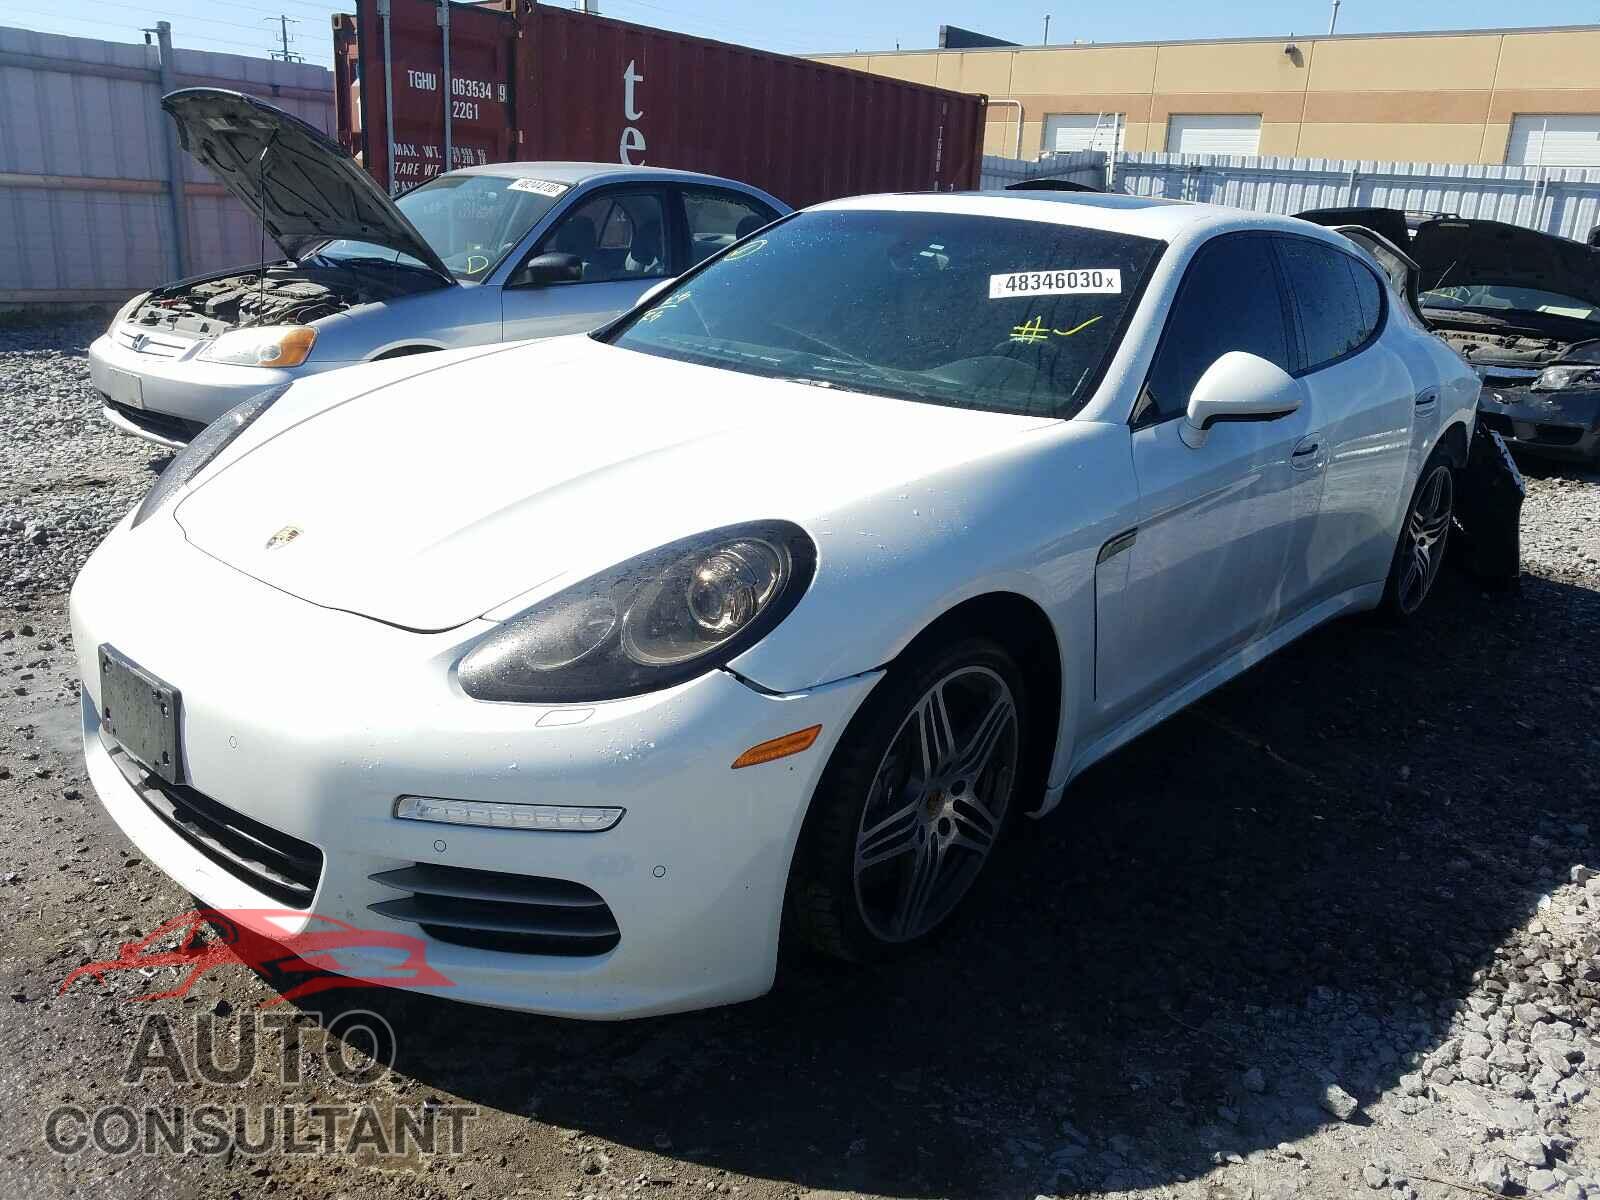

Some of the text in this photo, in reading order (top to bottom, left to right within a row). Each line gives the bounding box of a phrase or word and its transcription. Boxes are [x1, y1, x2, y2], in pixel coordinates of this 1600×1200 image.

[407, 70, 436, 92] TGHU
[452, 78, 492, 100] 063534
[452, 101, 479, 120] 22G1
[393, 143, 420, 157] MAX.
[423, 145, 442, 159] WT.
[395, 161, 420, 176] TARE
[467, 255, 489, 275] D
[1005, 271, 1104, 292] 48346030
